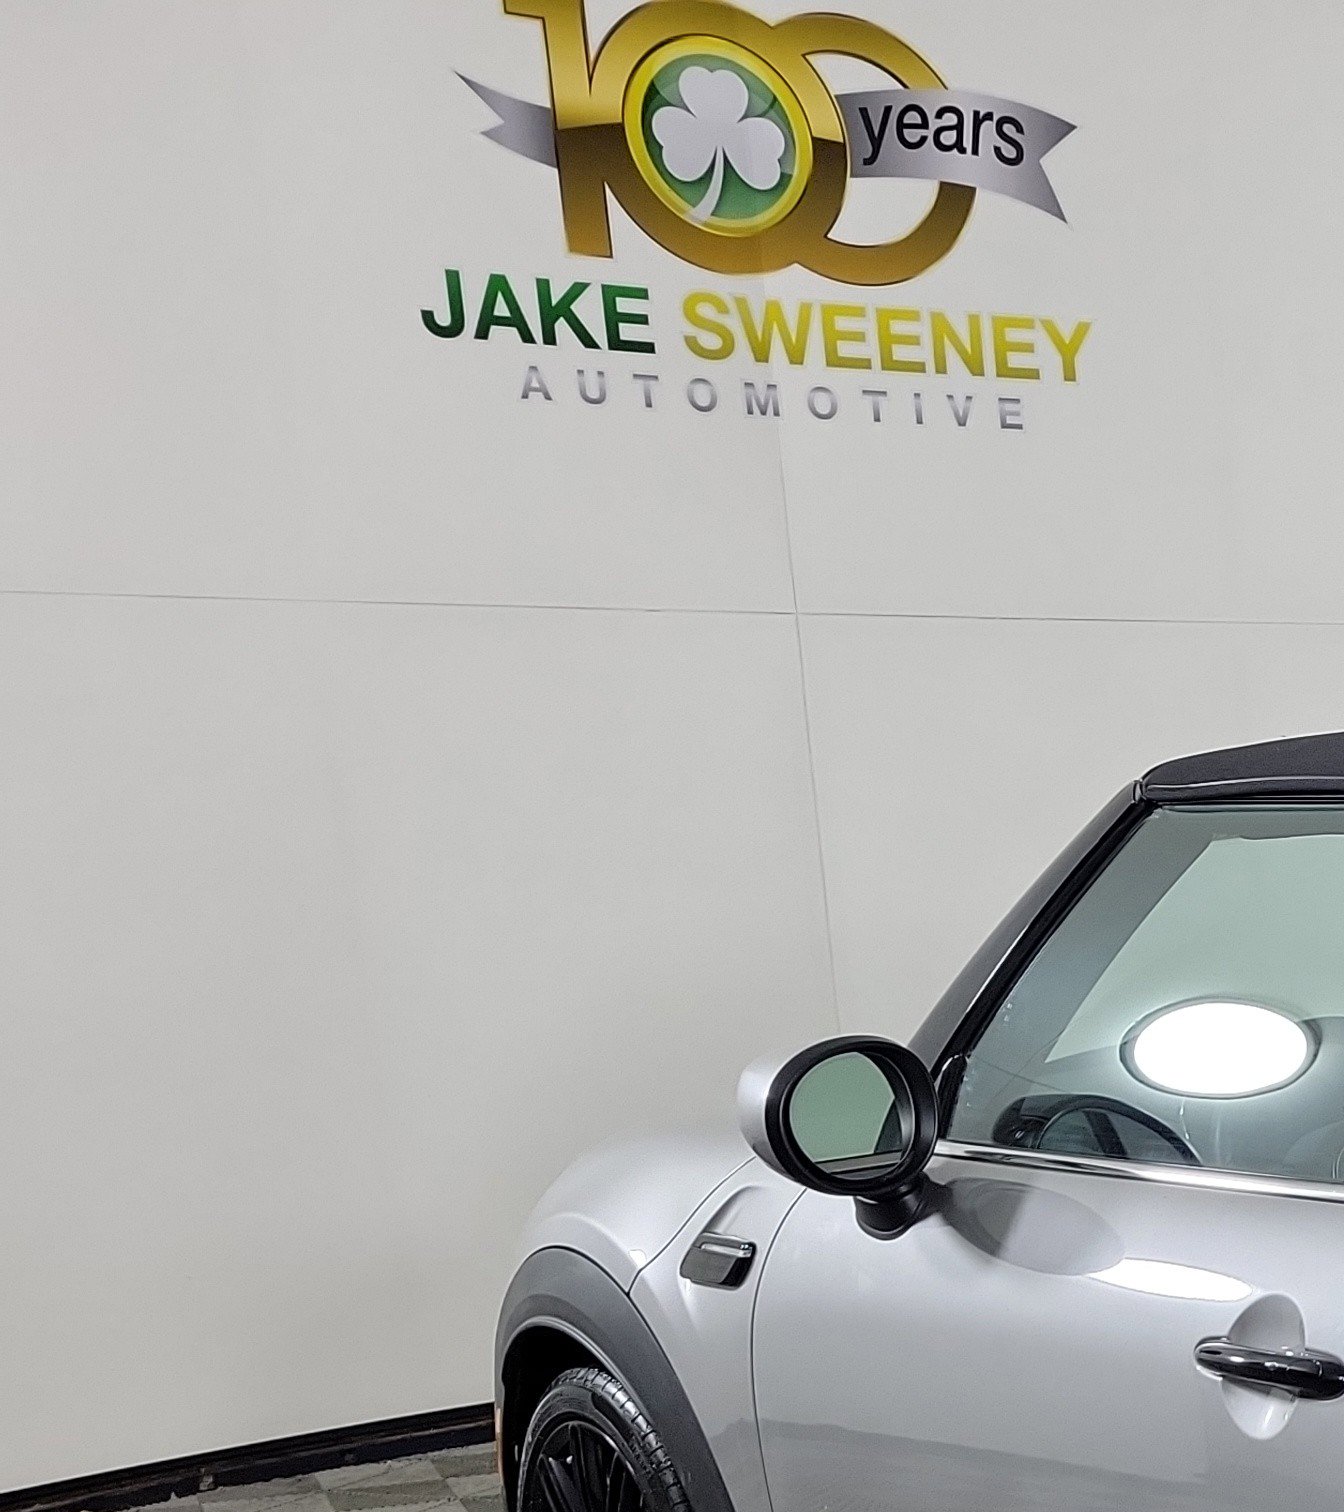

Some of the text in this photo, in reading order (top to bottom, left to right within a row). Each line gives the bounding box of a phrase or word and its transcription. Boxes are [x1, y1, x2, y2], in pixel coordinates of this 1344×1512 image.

[858, 101, 1026, 167] years
[420, 268, 1093, 385] JAKE SWEENEY
[521, 364, 1025, 431] AUTOMOTIVE
